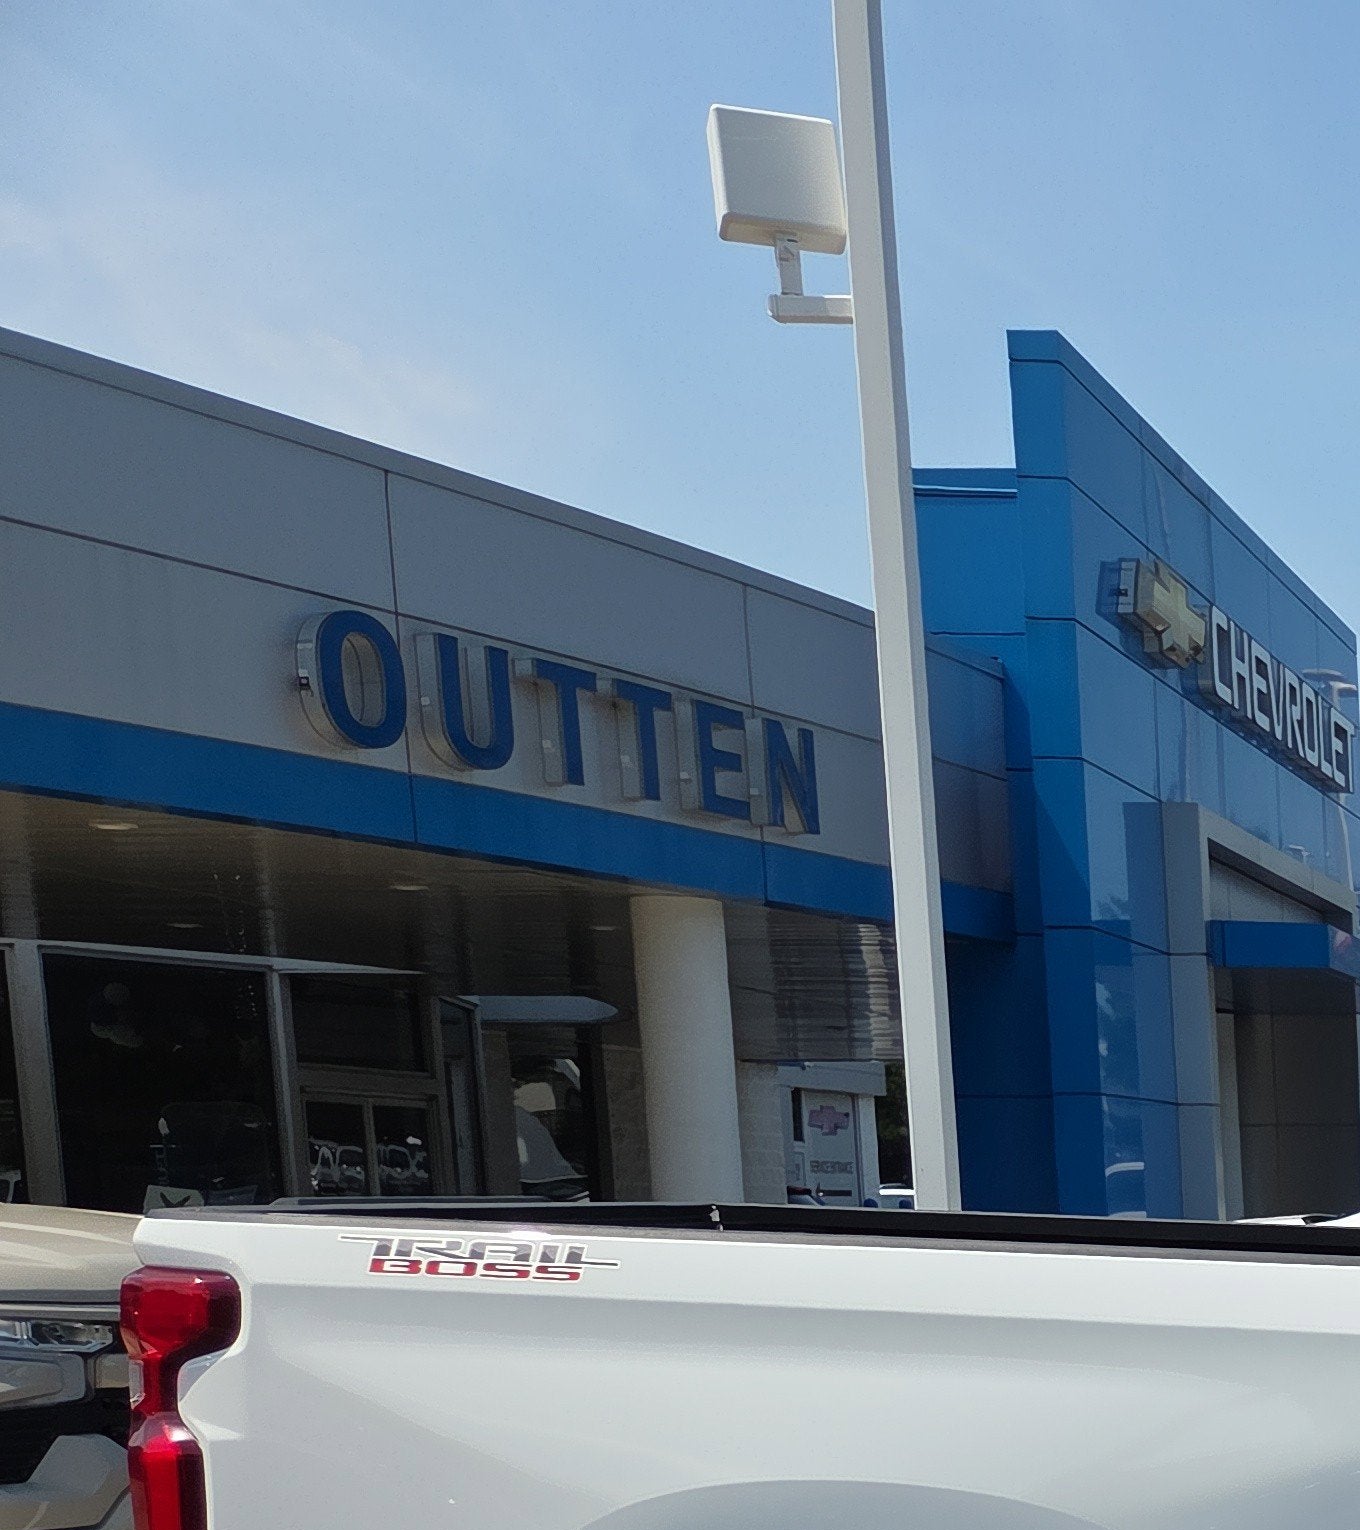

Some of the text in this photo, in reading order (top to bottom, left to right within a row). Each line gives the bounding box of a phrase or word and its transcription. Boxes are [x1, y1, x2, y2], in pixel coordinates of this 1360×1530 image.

[299, 609, 821, 835] OUTTEN
[1211, 605, 1355, 793] CHEVROLET
[340, 1235, 620, 1267] TRAIL
[368, 1256, 584, 1282] BOSS
